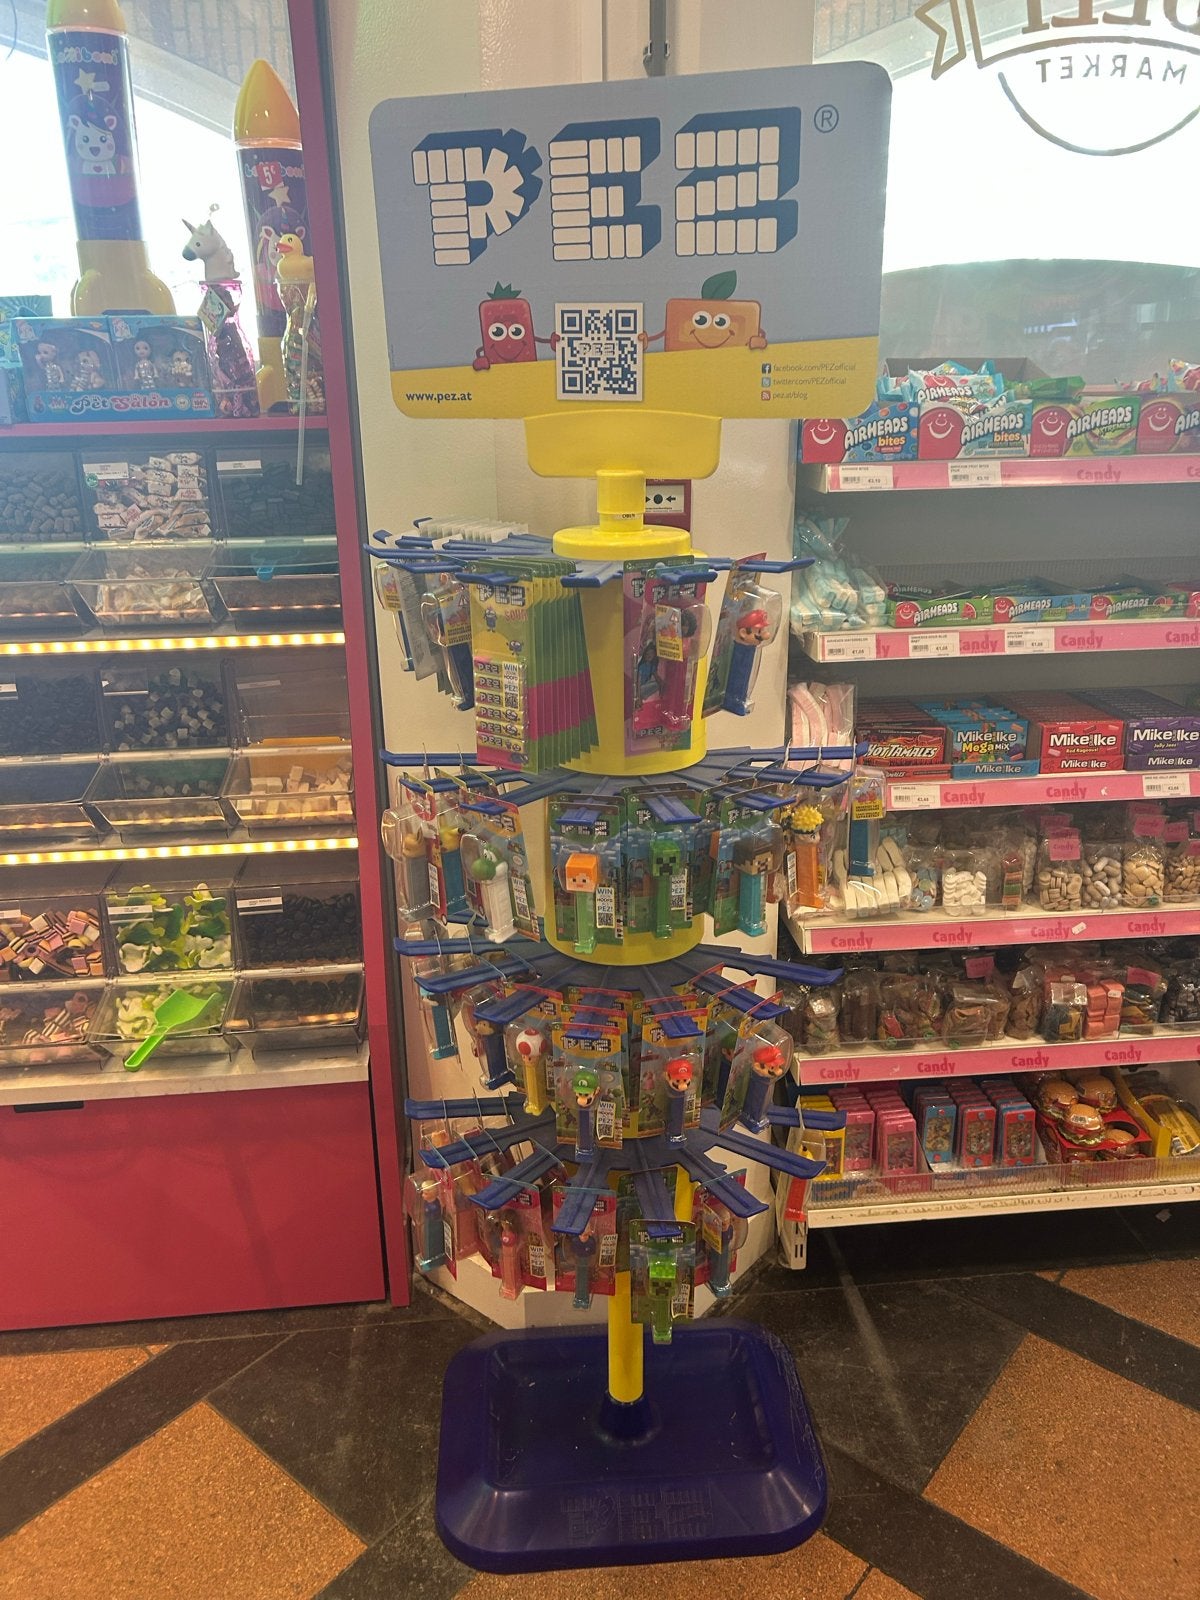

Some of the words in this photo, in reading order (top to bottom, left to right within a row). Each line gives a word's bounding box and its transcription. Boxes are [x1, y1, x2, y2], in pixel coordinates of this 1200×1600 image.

[412, 106, 801, 266] PEZ
[405, 390, 473, 403] www.pez.at
[772, 391, 808, 401] pez.at/blog
[917, 386, 974, 405] AIRHEADS
[960, 413, 1025, 446] AIRHEADS
[1066, 406, 1133, 439] AIRHEADS
[1174, 410, 1200, 435] AIR
[844, 416, 910, 451] AIRHEADS
[878, 435, 907, 447] bites
[993, 432, 1021, 443] bites
[1077, 462, 1122, 482] Candy
[914, 602, 958, 626] AIRHEADS
[1008, 598, 1052, 619] AIRHEADS
[1105, 597, 1150, 617] AIRHEADS
[959, 631, 998, 654] andy
[1061, 630, 1103, 648] Candy
[504, 663, 518, 672] WIN
[957, 730, 993, 742] Mike
[996, 731, 1017, 742] Ike
[1050, 734, 1090, 747] Mike
[1093, 735, 1117, 746] Ike
[1133, 729, 1173, 742] Mike
[1176, 729, 1200, 741] Ike
[885, 744, 938, 758] TAMALES
[962, 742, 994, 754] Mega
[975, 764, 1003, 774] Mike
[1005, 765, 1022, 773] Ike
[1061, 759, 1088, 769] Mike
[1090, 760, 1107, 768] Ike
[1148, 757, 1175, 766] Mike
[1177, 757, 1193, 765] Ike
[943, 785, 985, 804] Candy
[1046, 780, 1087, 800] Candy
[1030, 921, 1071, 939] Candy
[1127, 916, 1166, 934] Candy
[831, 931, 873, 949] Candy
[932, 926, 973, 944] Candy
[1012, 1051, 1050, 1068] Candy
[1104, 1045, 1142, 1062] Candy
[820, 1063, 860, 1080] Candy
[917, 1056, 956, 1074] Candy
[600, 1102, 615, 1110] WIN
